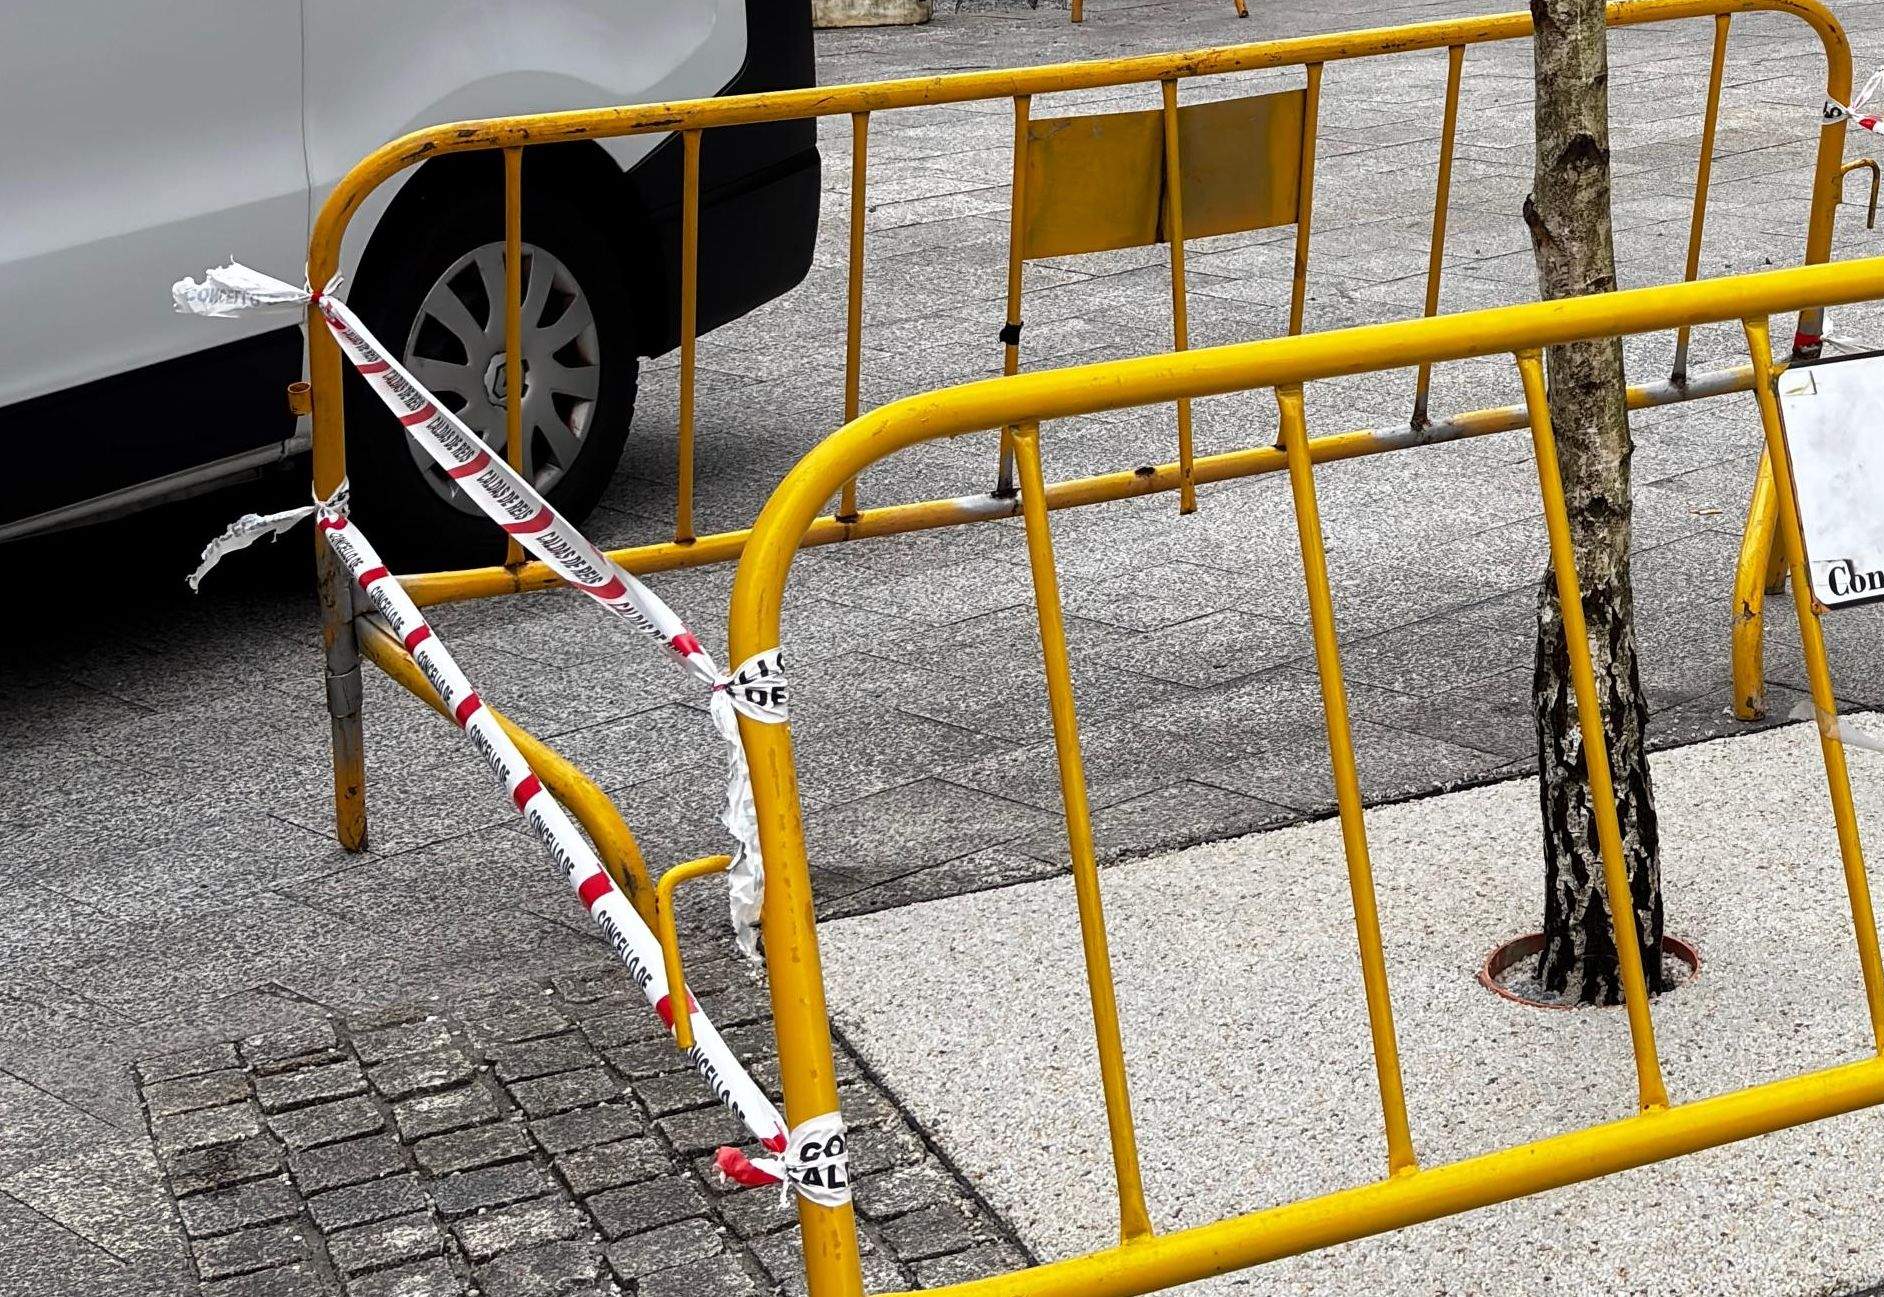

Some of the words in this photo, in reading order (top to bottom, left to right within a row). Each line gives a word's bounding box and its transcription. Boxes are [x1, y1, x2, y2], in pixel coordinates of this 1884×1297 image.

[426, 416, 455, 443] CALDAS
[450, 442, 475, 462] REIS
[477, 469, 511, 498] CALDAS
[497, 490, 520, 507] DE
[505, 499, 533, 520] REIS
[536, 531, 576, 560] CALDAS
[560, 555, 586, 568] DE
[571, 565, 603, 584] REIS
[371, 586, 398, 624] CONCELLO
[418, 650, 446, 695] CONCELLO
[470, 724, 501, 774] CONCELLO
[529, 809, 565, 865] CONCELLO
[598, 909, 640, 975] CONCELLO
[635, 966, 653, 990] DE
